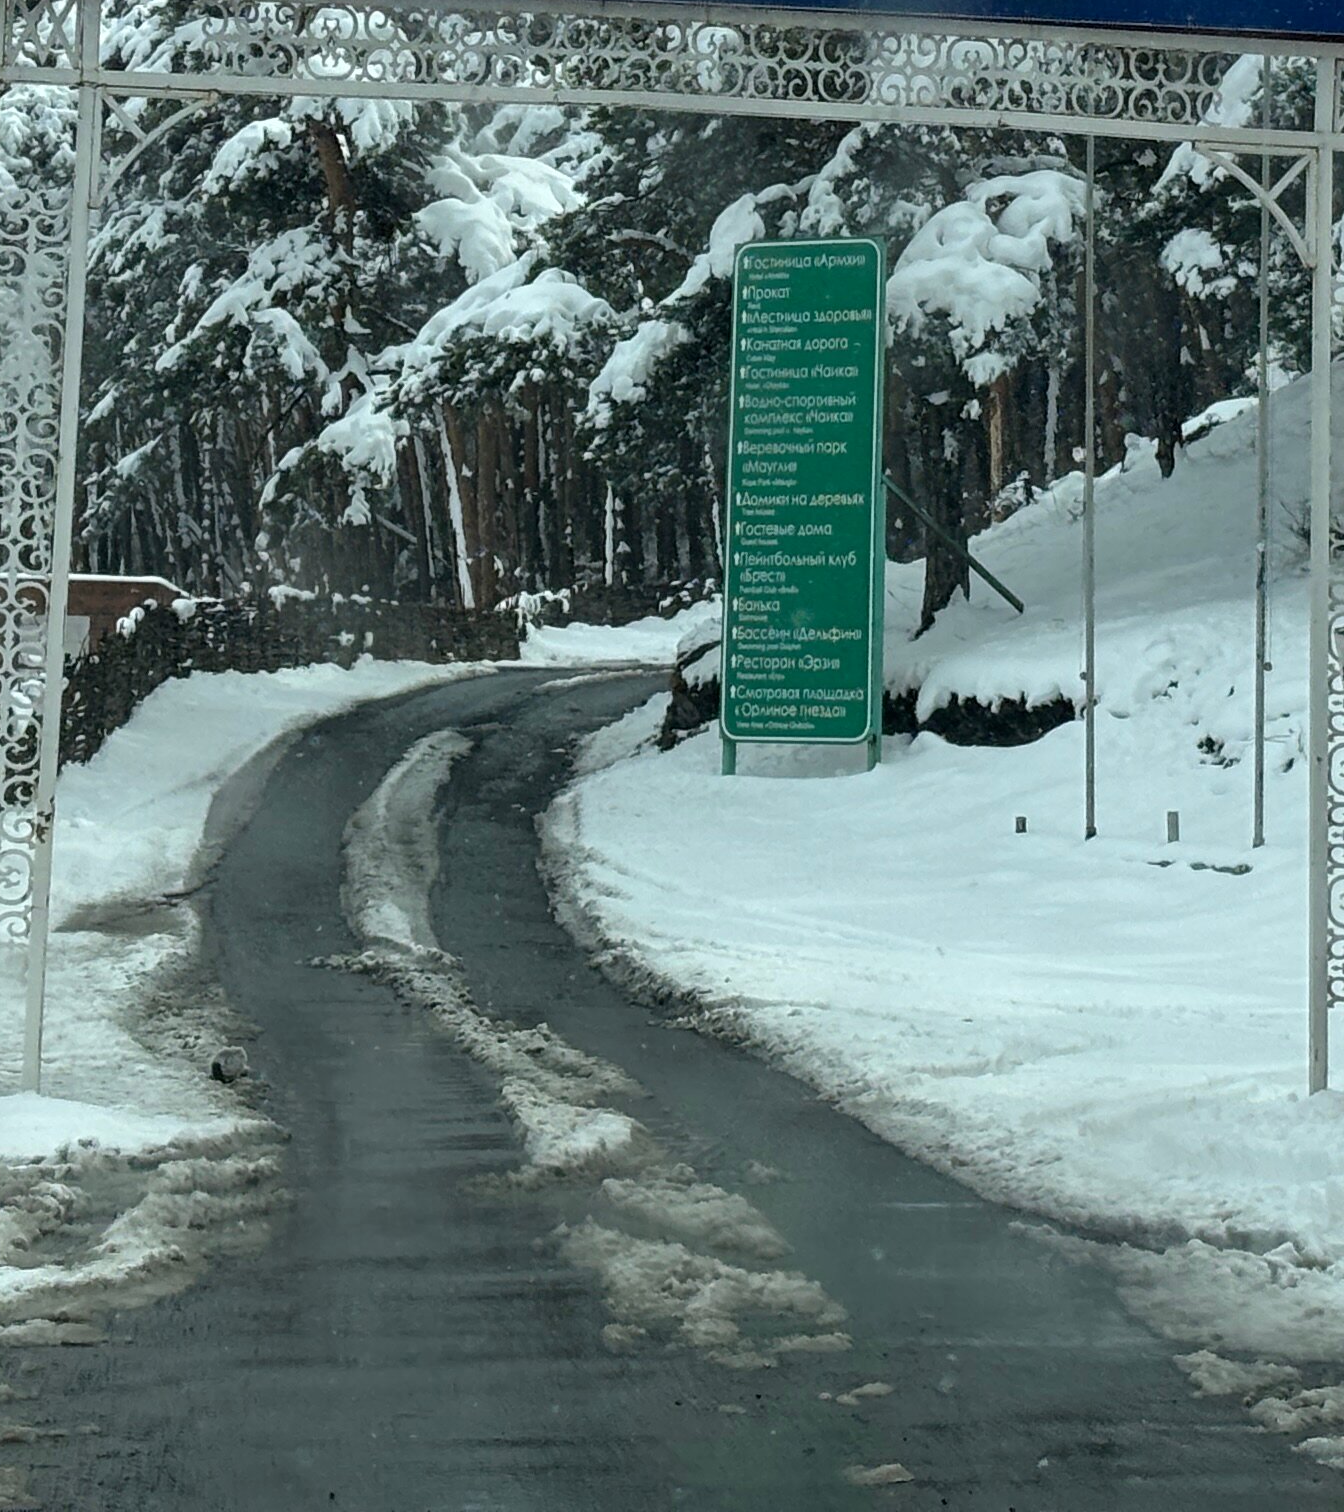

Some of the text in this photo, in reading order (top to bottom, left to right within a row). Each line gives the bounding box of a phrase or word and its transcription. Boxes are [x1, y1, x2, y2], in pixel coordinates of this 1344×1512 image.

[749, 255, 811, 270] Гостиница
[748, 285, 790, 301] Прокат
[746, 337, 849, 352] Канатная дорога
[745, 366, 808, 380] Гостиница
[744, 412, 803, 425] комплекс
[816, 441, 847, 458] парк
[742, 492, 865, 508] Домики на деревьях
[740, 522, 832, 537] Гостевые дома
[739, 551, 857, 569] Пейнтбольный клуб
[738, 597, 780, 612] Банька
[736, 654, 795, 670] Ресторан
[736, 685, 864, 701] Смотровая площадка
